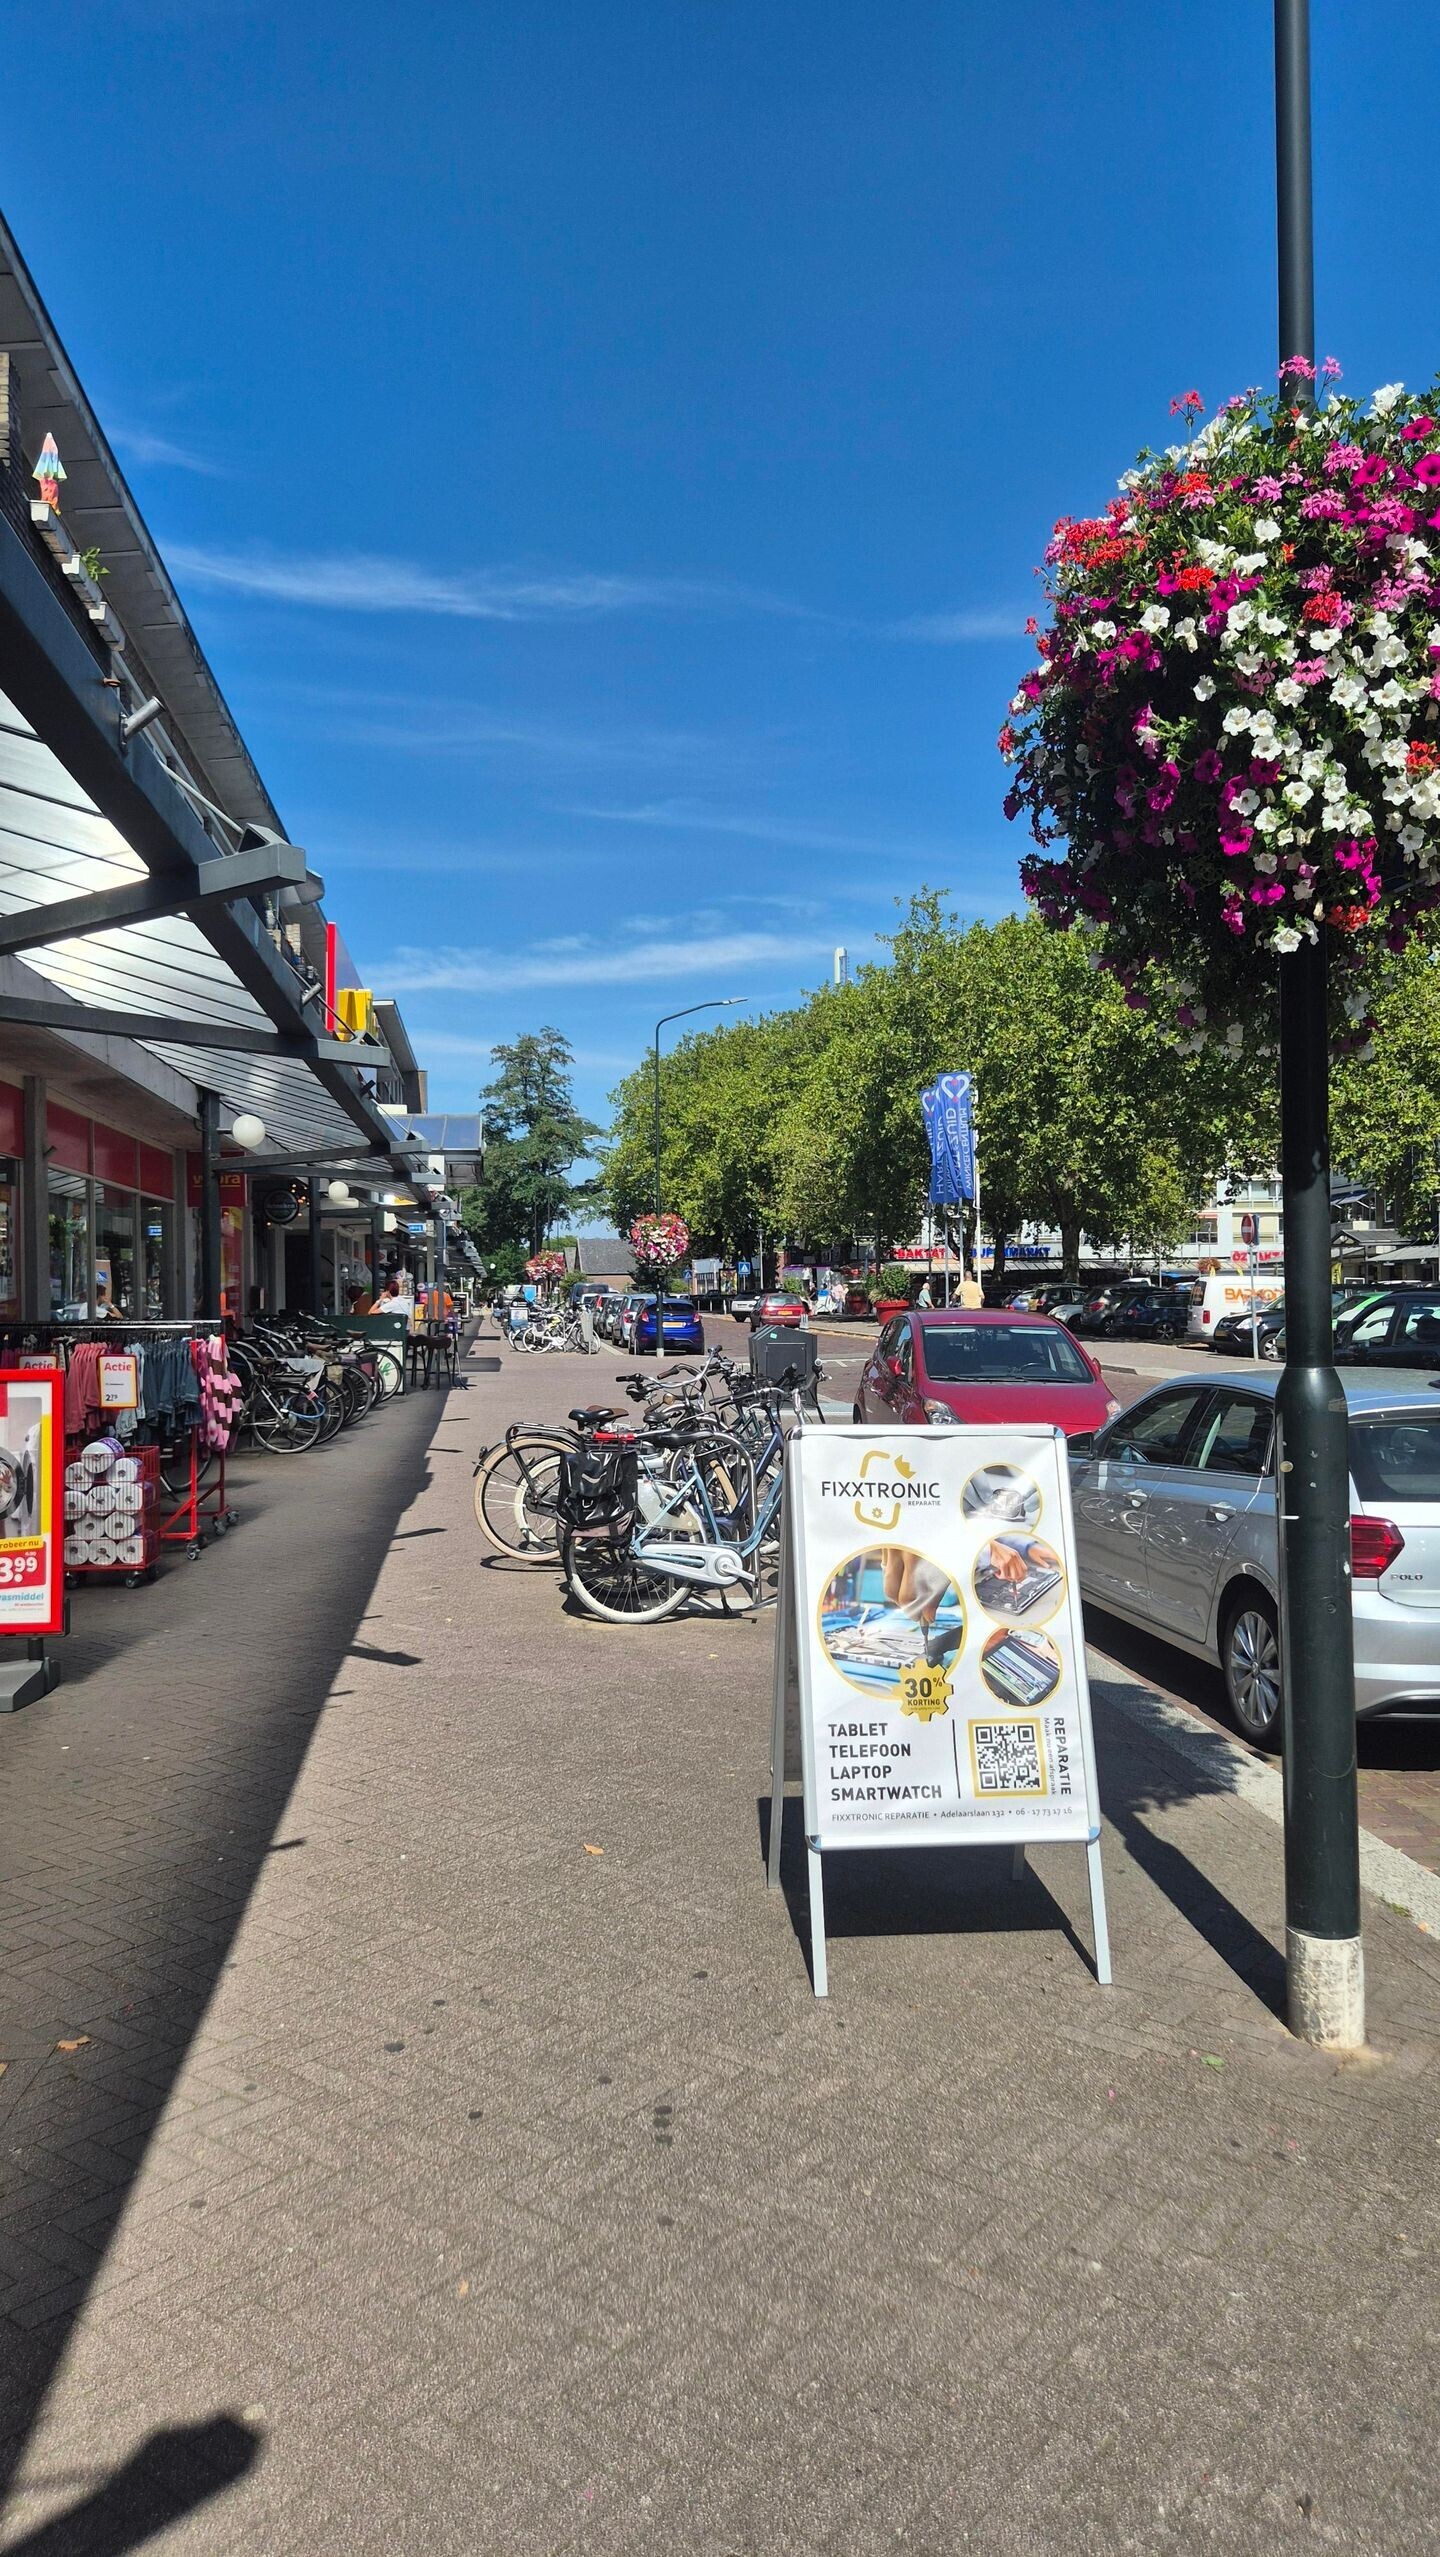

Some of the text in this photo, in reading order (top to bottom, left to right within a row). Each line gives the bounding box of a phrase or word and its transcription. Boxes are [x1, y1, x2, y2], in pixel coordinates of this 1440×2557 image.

[104, 1362, 132, 1371] Actie
[821, 1481, 941, 1498] FIXXTRONIC
[0, 1541, 27, 1549] robeer
[905, 1677, 943, 1698] 30%
[828, 1723, 888, 1737] TABLET
[829, 1743, 911, 1758] TELEFOON
[1054, 1718, 1072, 1795] REPARATIE
[830, 1765, 892, 1780] LAPTOP
[831, 1785, 942, 1801] SMARTWATCH
[832, 1813, 883, 1821] FIXXTRONIC
[885, 1811, 929, 1820] REPARATIE
[940, 1810, 991, 1819] Adelaarslaan
[992, 1810, 1005, 1818] 132
[1015, 1807, 1026, 1815] 06
